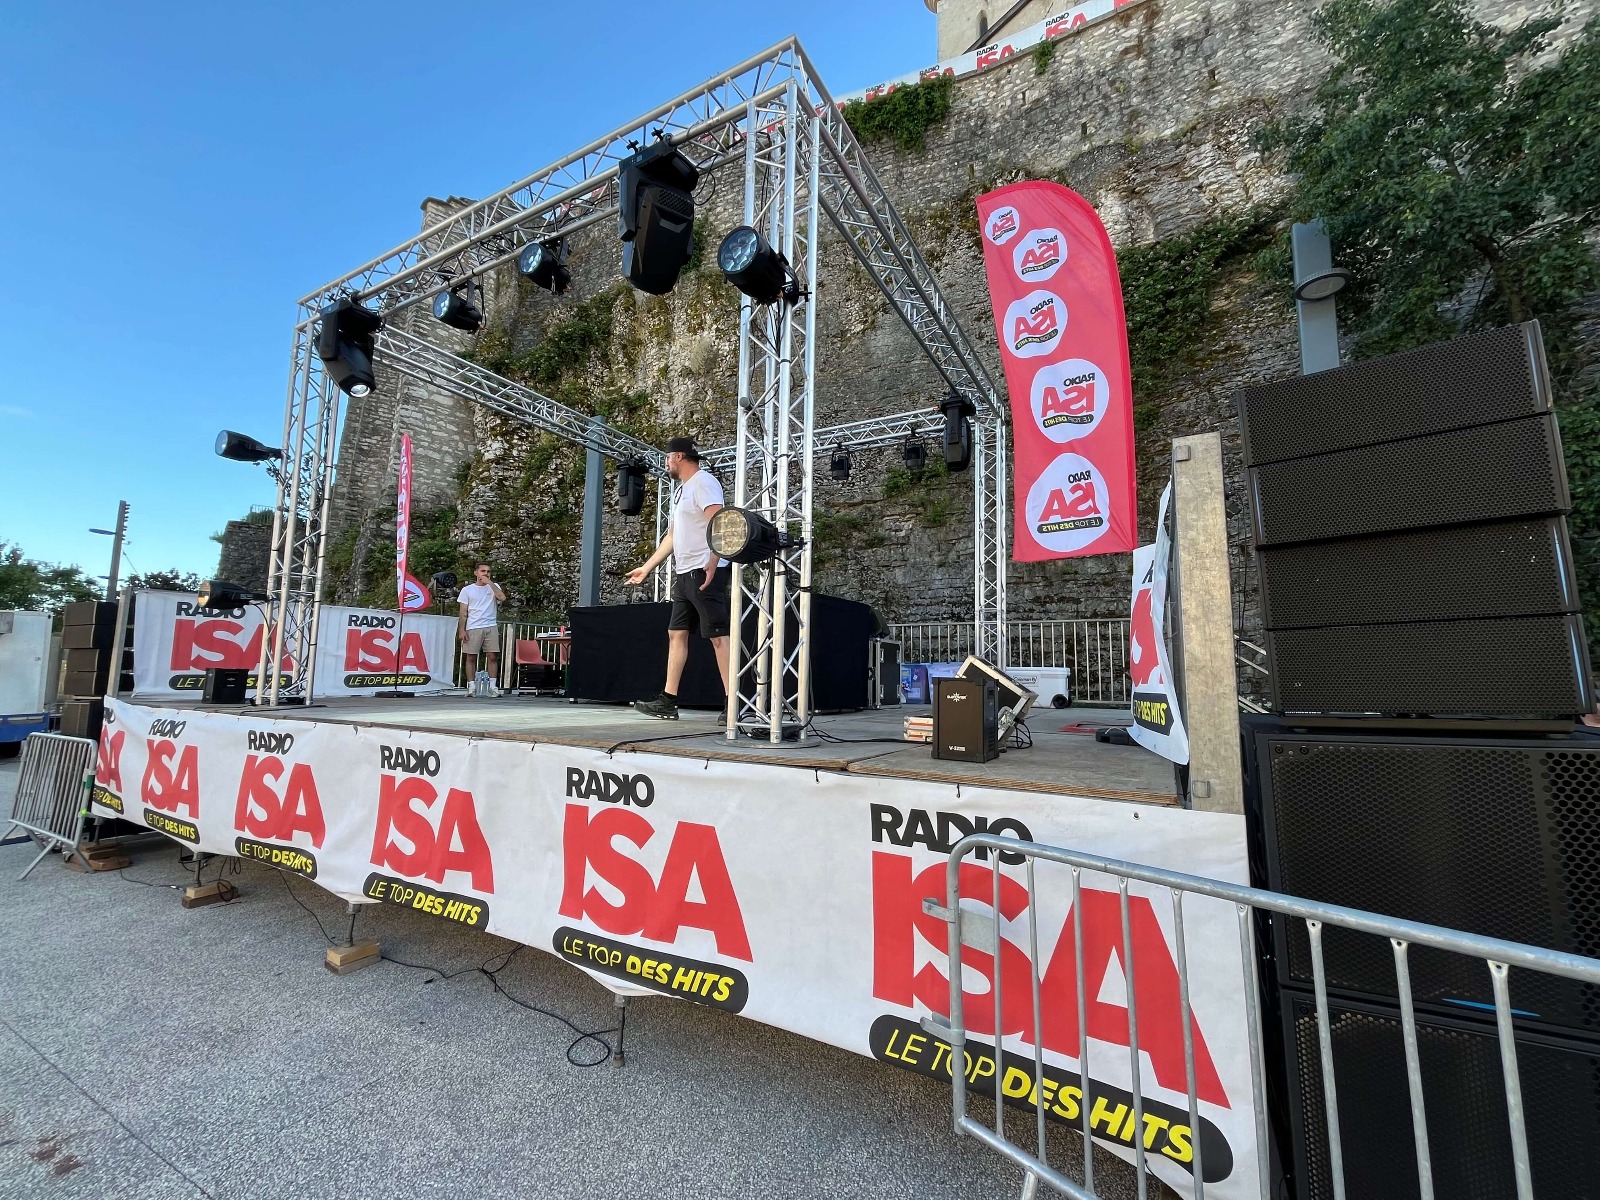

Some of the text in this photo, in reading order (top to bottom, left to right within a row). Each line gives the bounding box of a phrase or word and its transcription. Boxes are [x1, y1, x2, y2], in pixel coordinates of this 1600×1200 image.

[1045, 12, 1069, 27] RADIO
[976, 44, 998, 57] RADIO
[919, 65, 940, 77] RADIO
[347, 614, 396, 629] RADIO
[344, 628, 430, 672] ISA
[176, 678, 193, 688] LE
[349, 677, 361, 685] LE
[363, 677, 381, 685] TOP
[402, 676, 426, 684] HITS
[148, 718, 187, 738] RADIO
[1151, 702, 1167, 726] HITS
[247, 729, 295, 755] RADIO
[379, 744, 441, 777] RADIO
[141, 738, 199, 819] ISA
[565, 766, 655, 808] RADIO
[234, 754, 326, 850] ISA
[146, 812, 196, 840] LE TOP DES HITS
[369, 773, 495, 895] ISA
[869, 803, 1034, 866] RADIO
[240, 841, 313, 874] LE TOP DES HITS
[558, 803, 754, 964] ISA
[368, 879, 482, 926] LE TOP DES HITS
[563, 935, 735, 1002] LE TOP DES HITS
[871, 850, 1232, 1111] ISA
[884, 1028, 927, 1065] LE
[1001, 1065, 1084, 1120] DES
[1089, 1096, 1194, 1163] HITS
